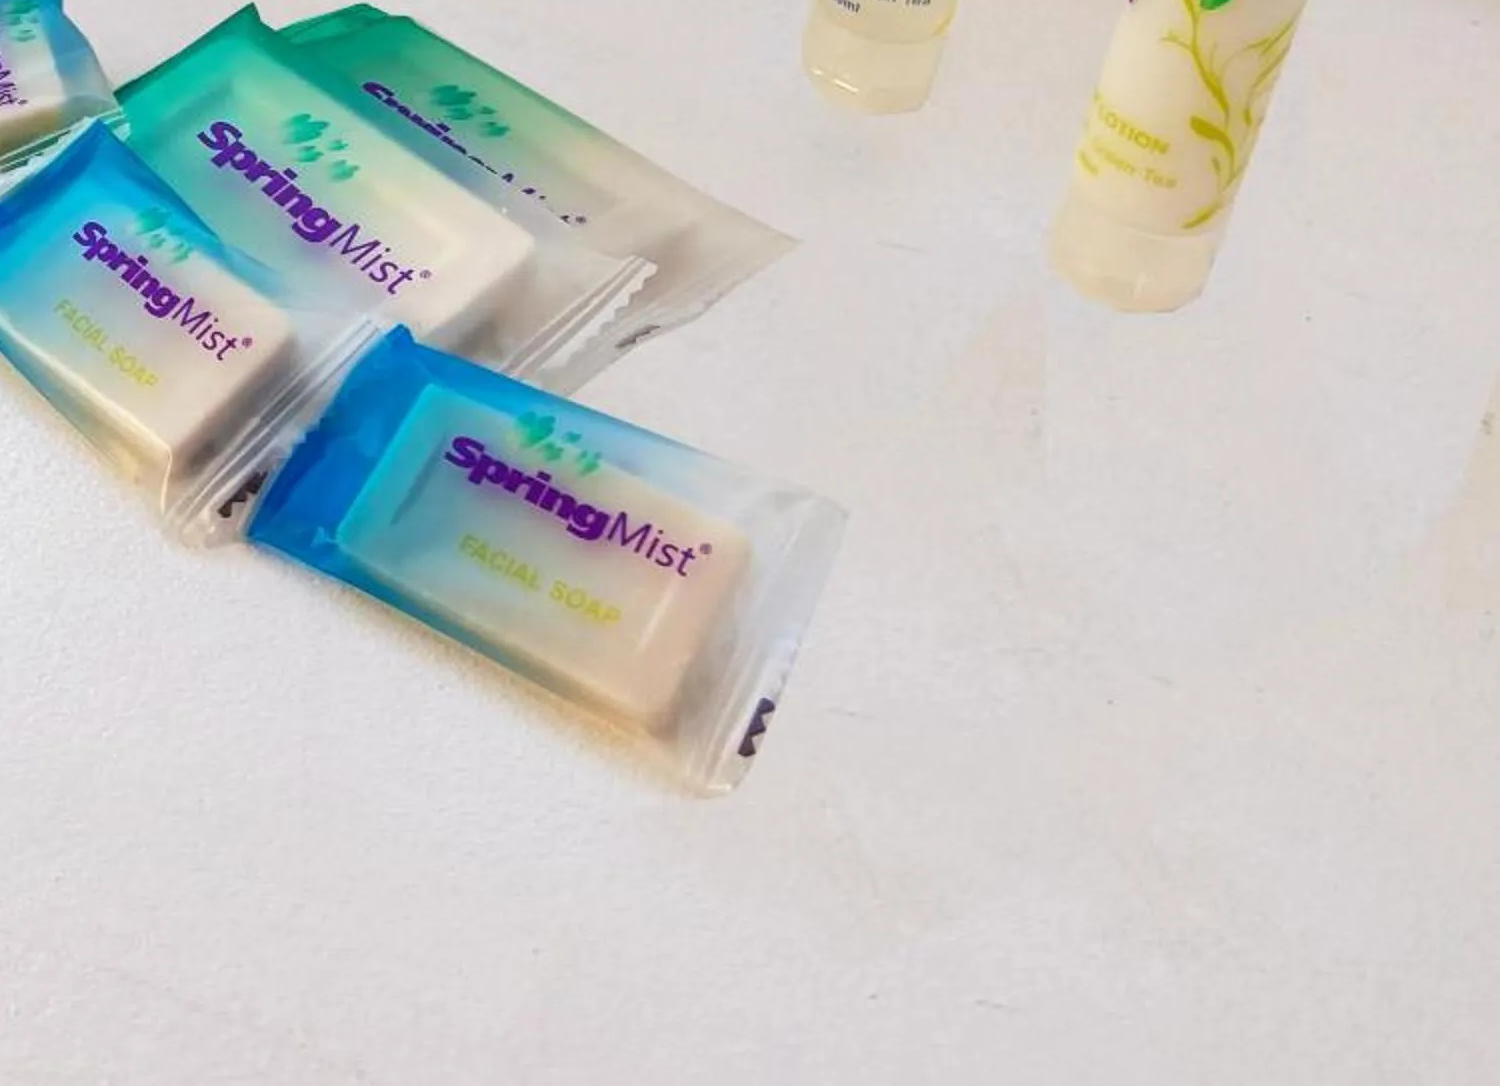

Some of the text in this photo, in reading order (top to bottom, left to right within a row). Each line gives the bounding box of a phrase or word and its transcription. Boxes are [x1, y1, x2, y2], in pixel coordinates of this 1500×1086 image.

[109, 345, 159, 386] SOAP
[459, 534, 622, 622] FACIAL SOAP
